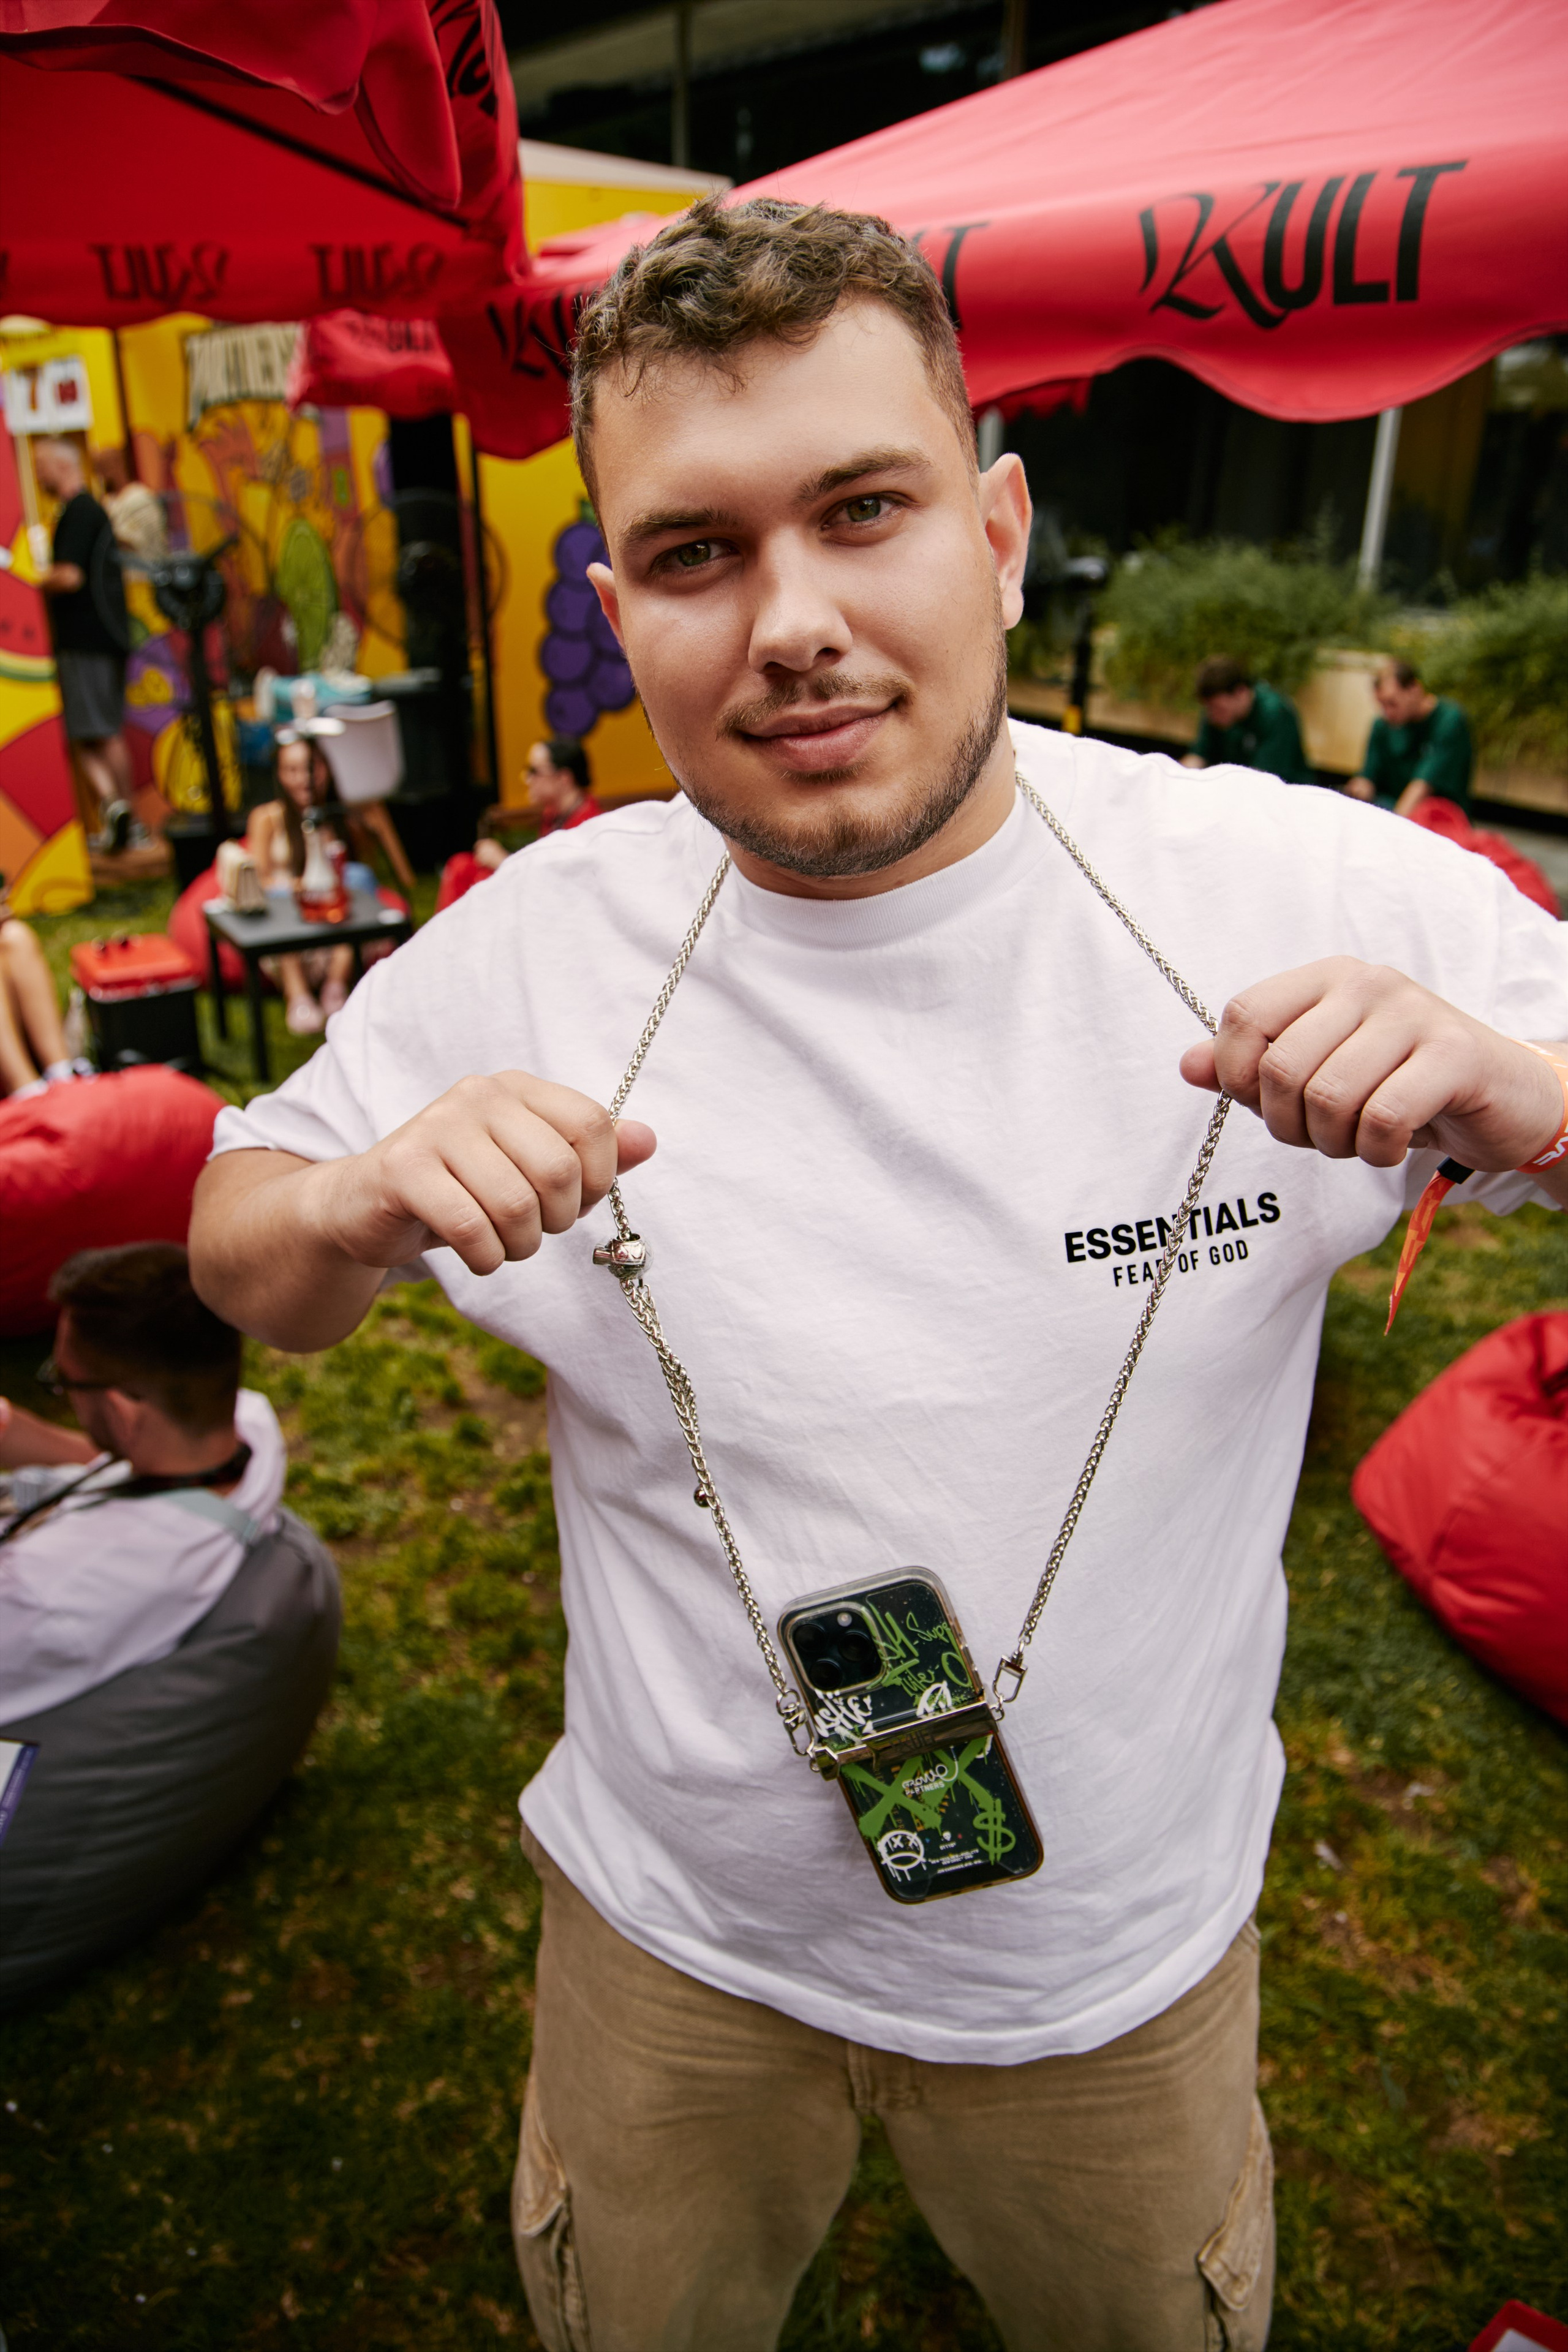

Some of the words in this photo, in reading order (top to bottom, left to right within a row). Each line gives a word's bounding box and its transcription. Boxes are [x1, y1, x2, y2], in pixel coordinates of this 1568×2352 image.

[1137, 160, 1469, 330] KULT
[1064, 1192, 1281, 1263] ESSENTIALS
[1113, 1258, 1167, 1287] FEA
[1178, 1250, 1199, 1273] OF
[1209, 1240, 1249, 1265] GOD
[905, 1781, 945, 1795] PARTNERS
